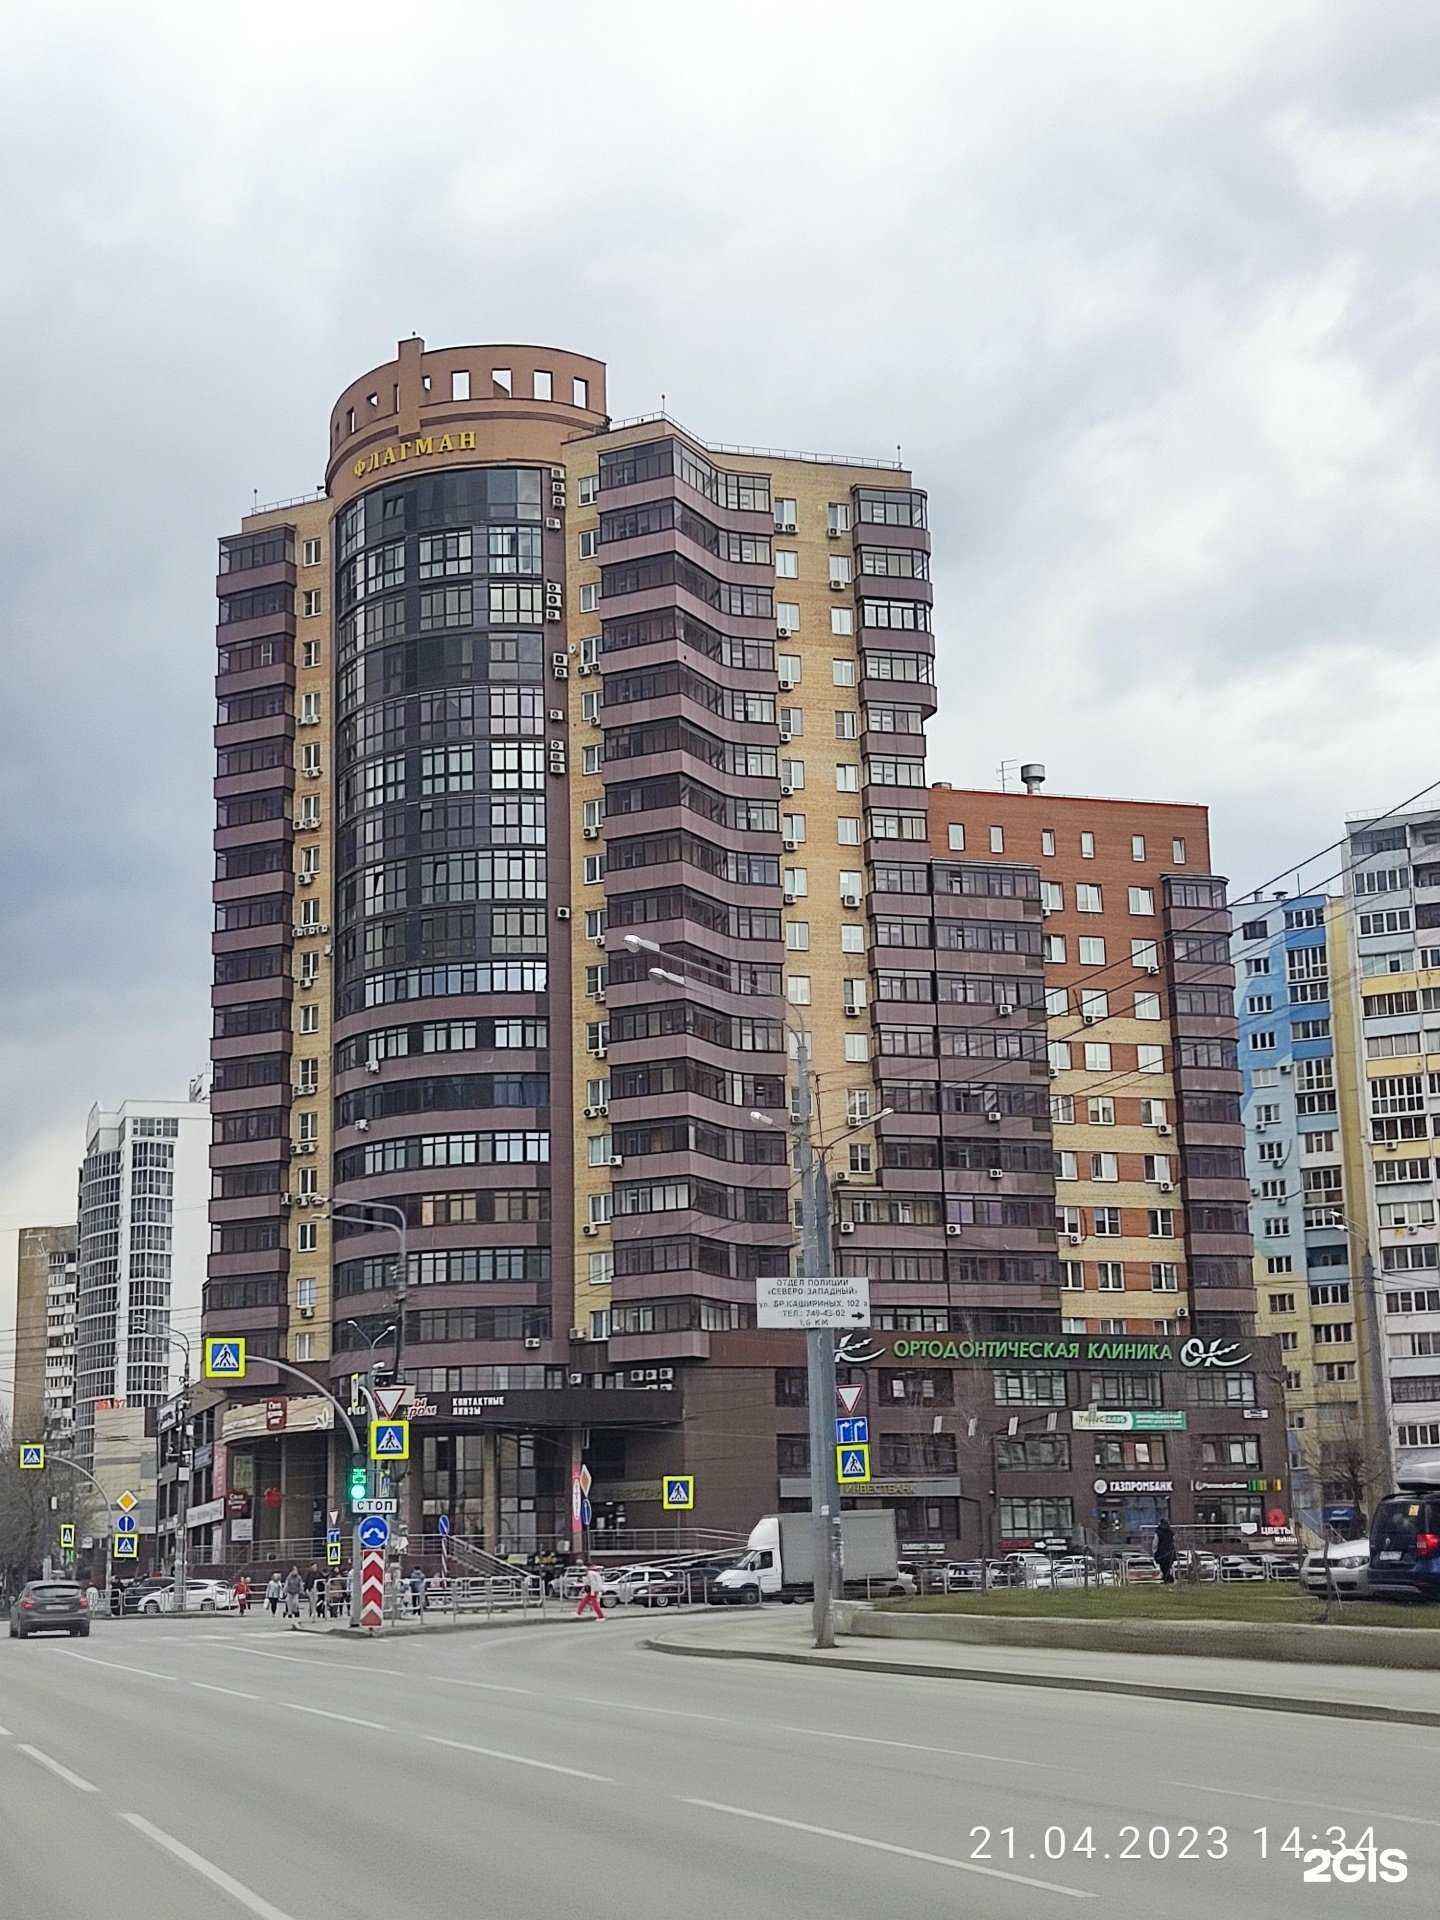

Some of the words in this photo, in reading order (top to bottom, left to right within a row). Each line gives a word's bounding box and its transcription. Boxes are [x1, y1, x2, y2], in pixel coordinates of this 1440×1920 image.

[353, 431, 477, 478] ФЛАГМАН
[776, 1279, 805, 1287] ОТДЕЛ
[893, 1339, 1080, 1359] ОРТОДОНТИЧЕСКАЯ
[1087, 1342, 1173, 1360] КЛИНИКА
[452, 1396, 505, 1407] КОНТАКТНЫЕ
[1109, 1480, 1174, 1492] ГАЗПРОМБАНК
[357, 1500, 393, 1511] СТОП
[1260, 1526, 1294, 1536] ЦВЕТЫ
